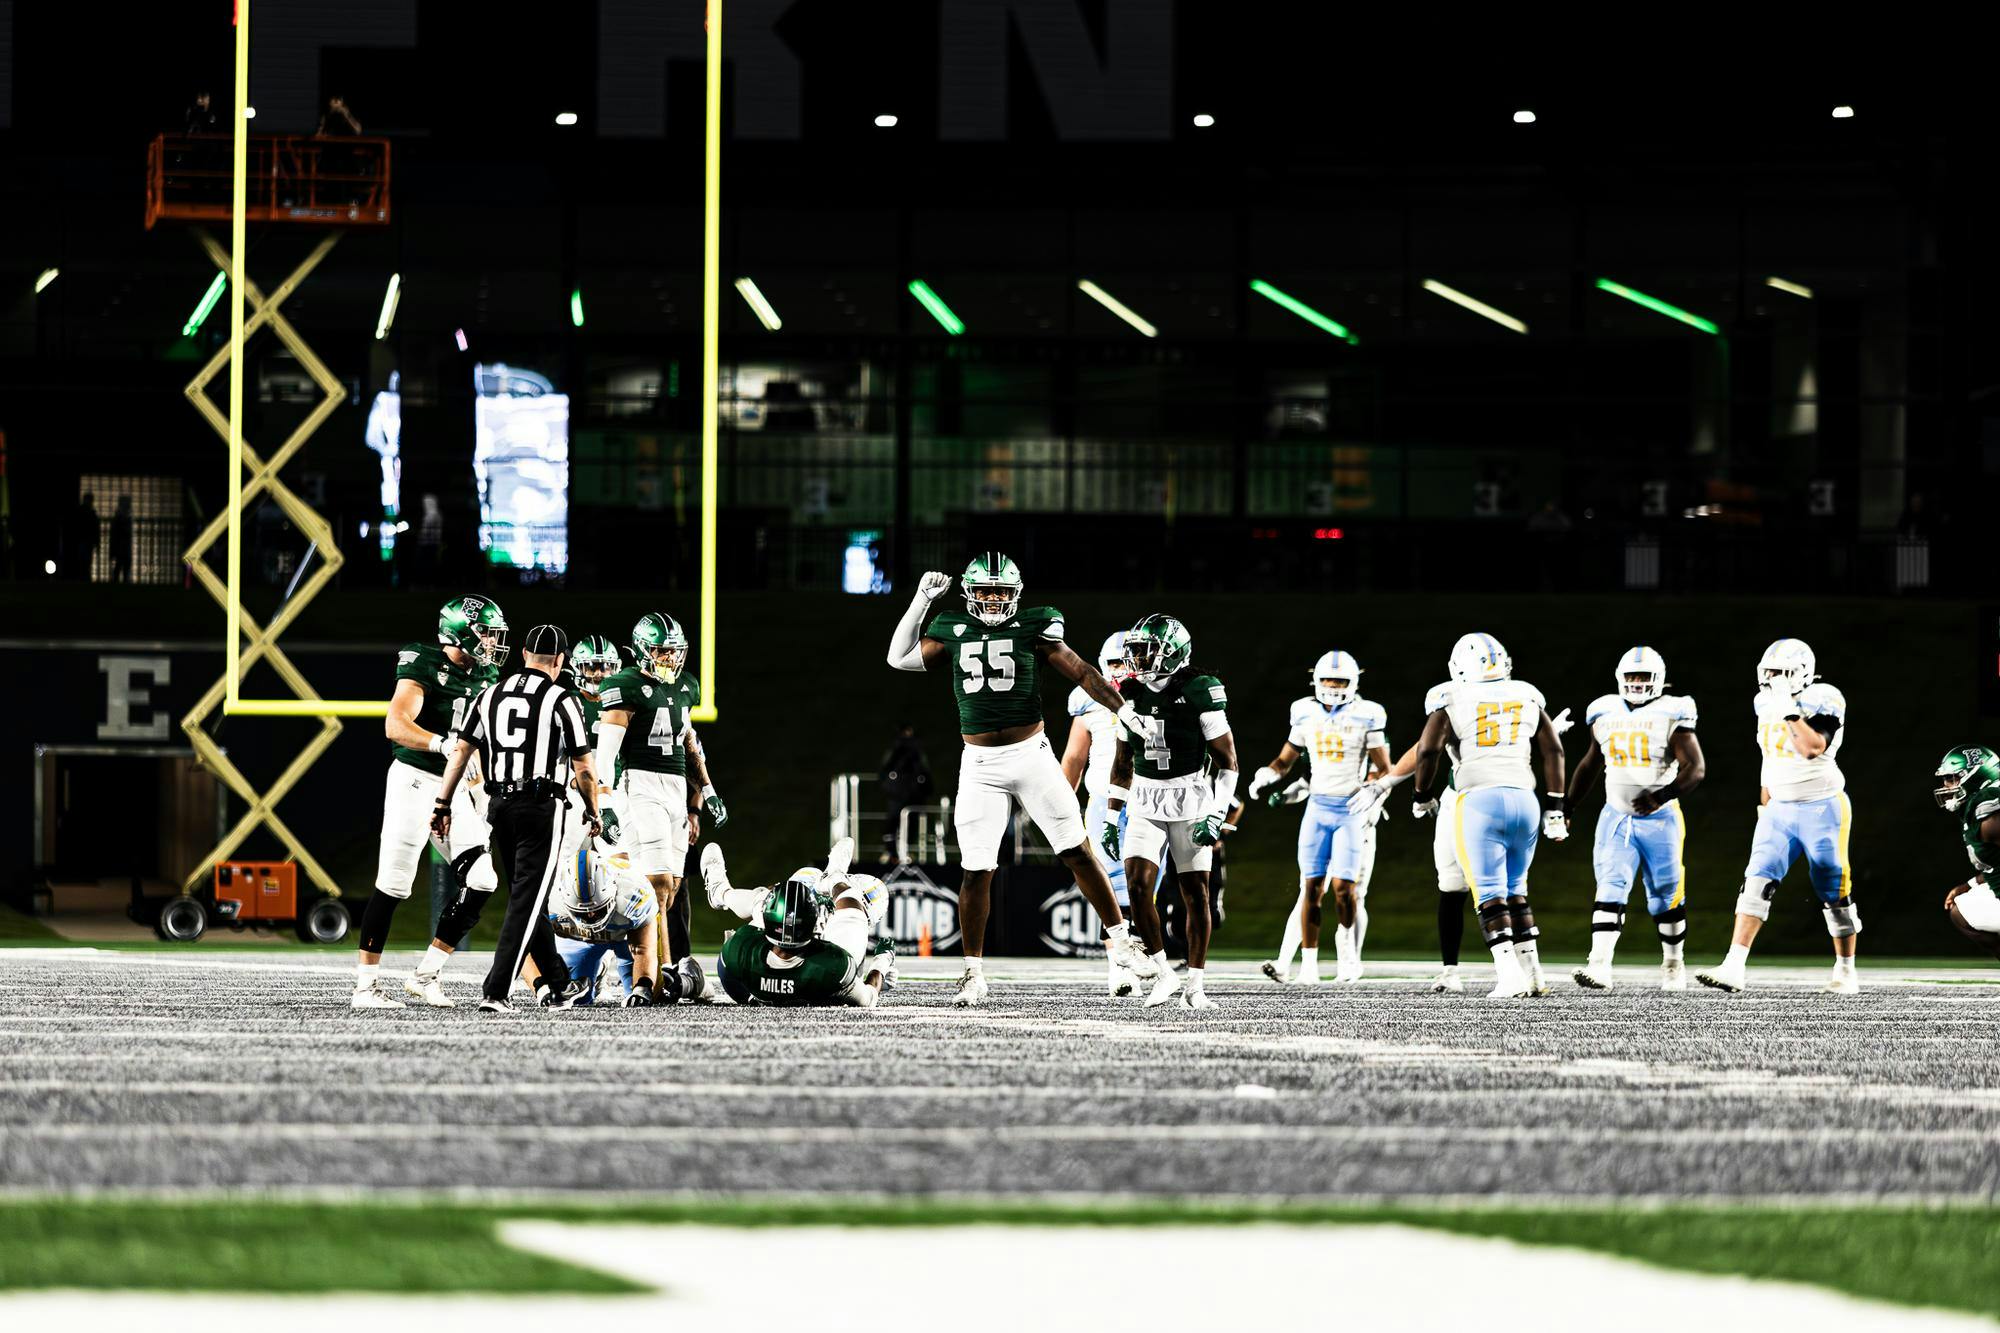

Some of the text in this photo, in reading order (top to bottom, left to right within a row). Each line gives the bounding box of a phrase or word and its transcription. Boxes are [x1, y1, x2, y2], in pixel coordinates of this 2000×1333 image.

[959, 639, 1015, 694] 55
[97, 656, 171, 742] E
[496, 697, 530, 748] C
[1144, 719, 1171, 770] 4
[1475, 701, 1523, 747] 67
[867, 896, 954, 940] LIMB
[1051, 901, 1102, 944] CLI
[760, 976, 795, 994] MILES
